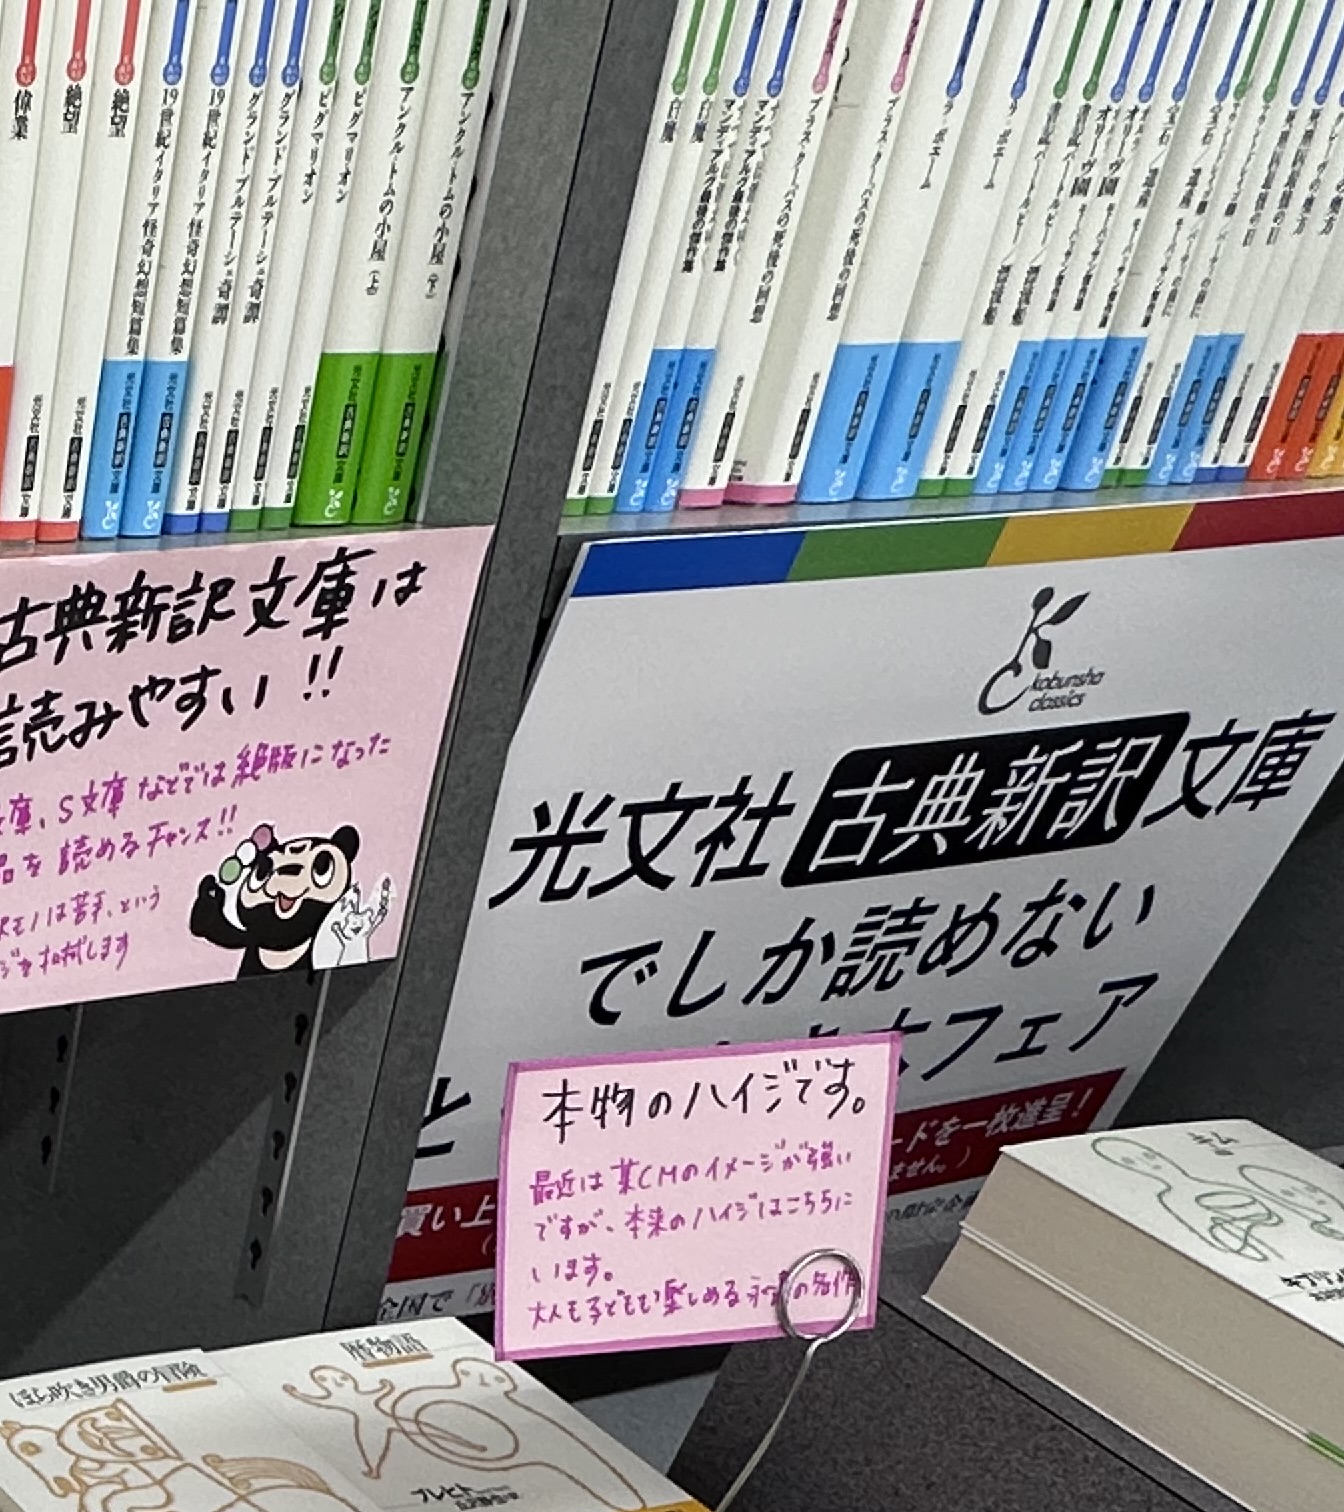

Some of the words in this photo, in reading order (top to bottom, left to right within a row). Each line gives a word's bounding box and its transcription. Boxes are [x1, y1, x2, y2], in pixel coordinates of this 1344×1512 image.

[1028, 689, 1088, 712] classics
[1029, 667, 1105, 696] kobunsha
[487, 709, 1336, 911] 光文社古典新訳文庫
[577, 878, 1157, 1027] でしか読めない
[541, 1057, 866, 1145] 本物のハイジです。
[531, 1253, 615, 1288] います。
